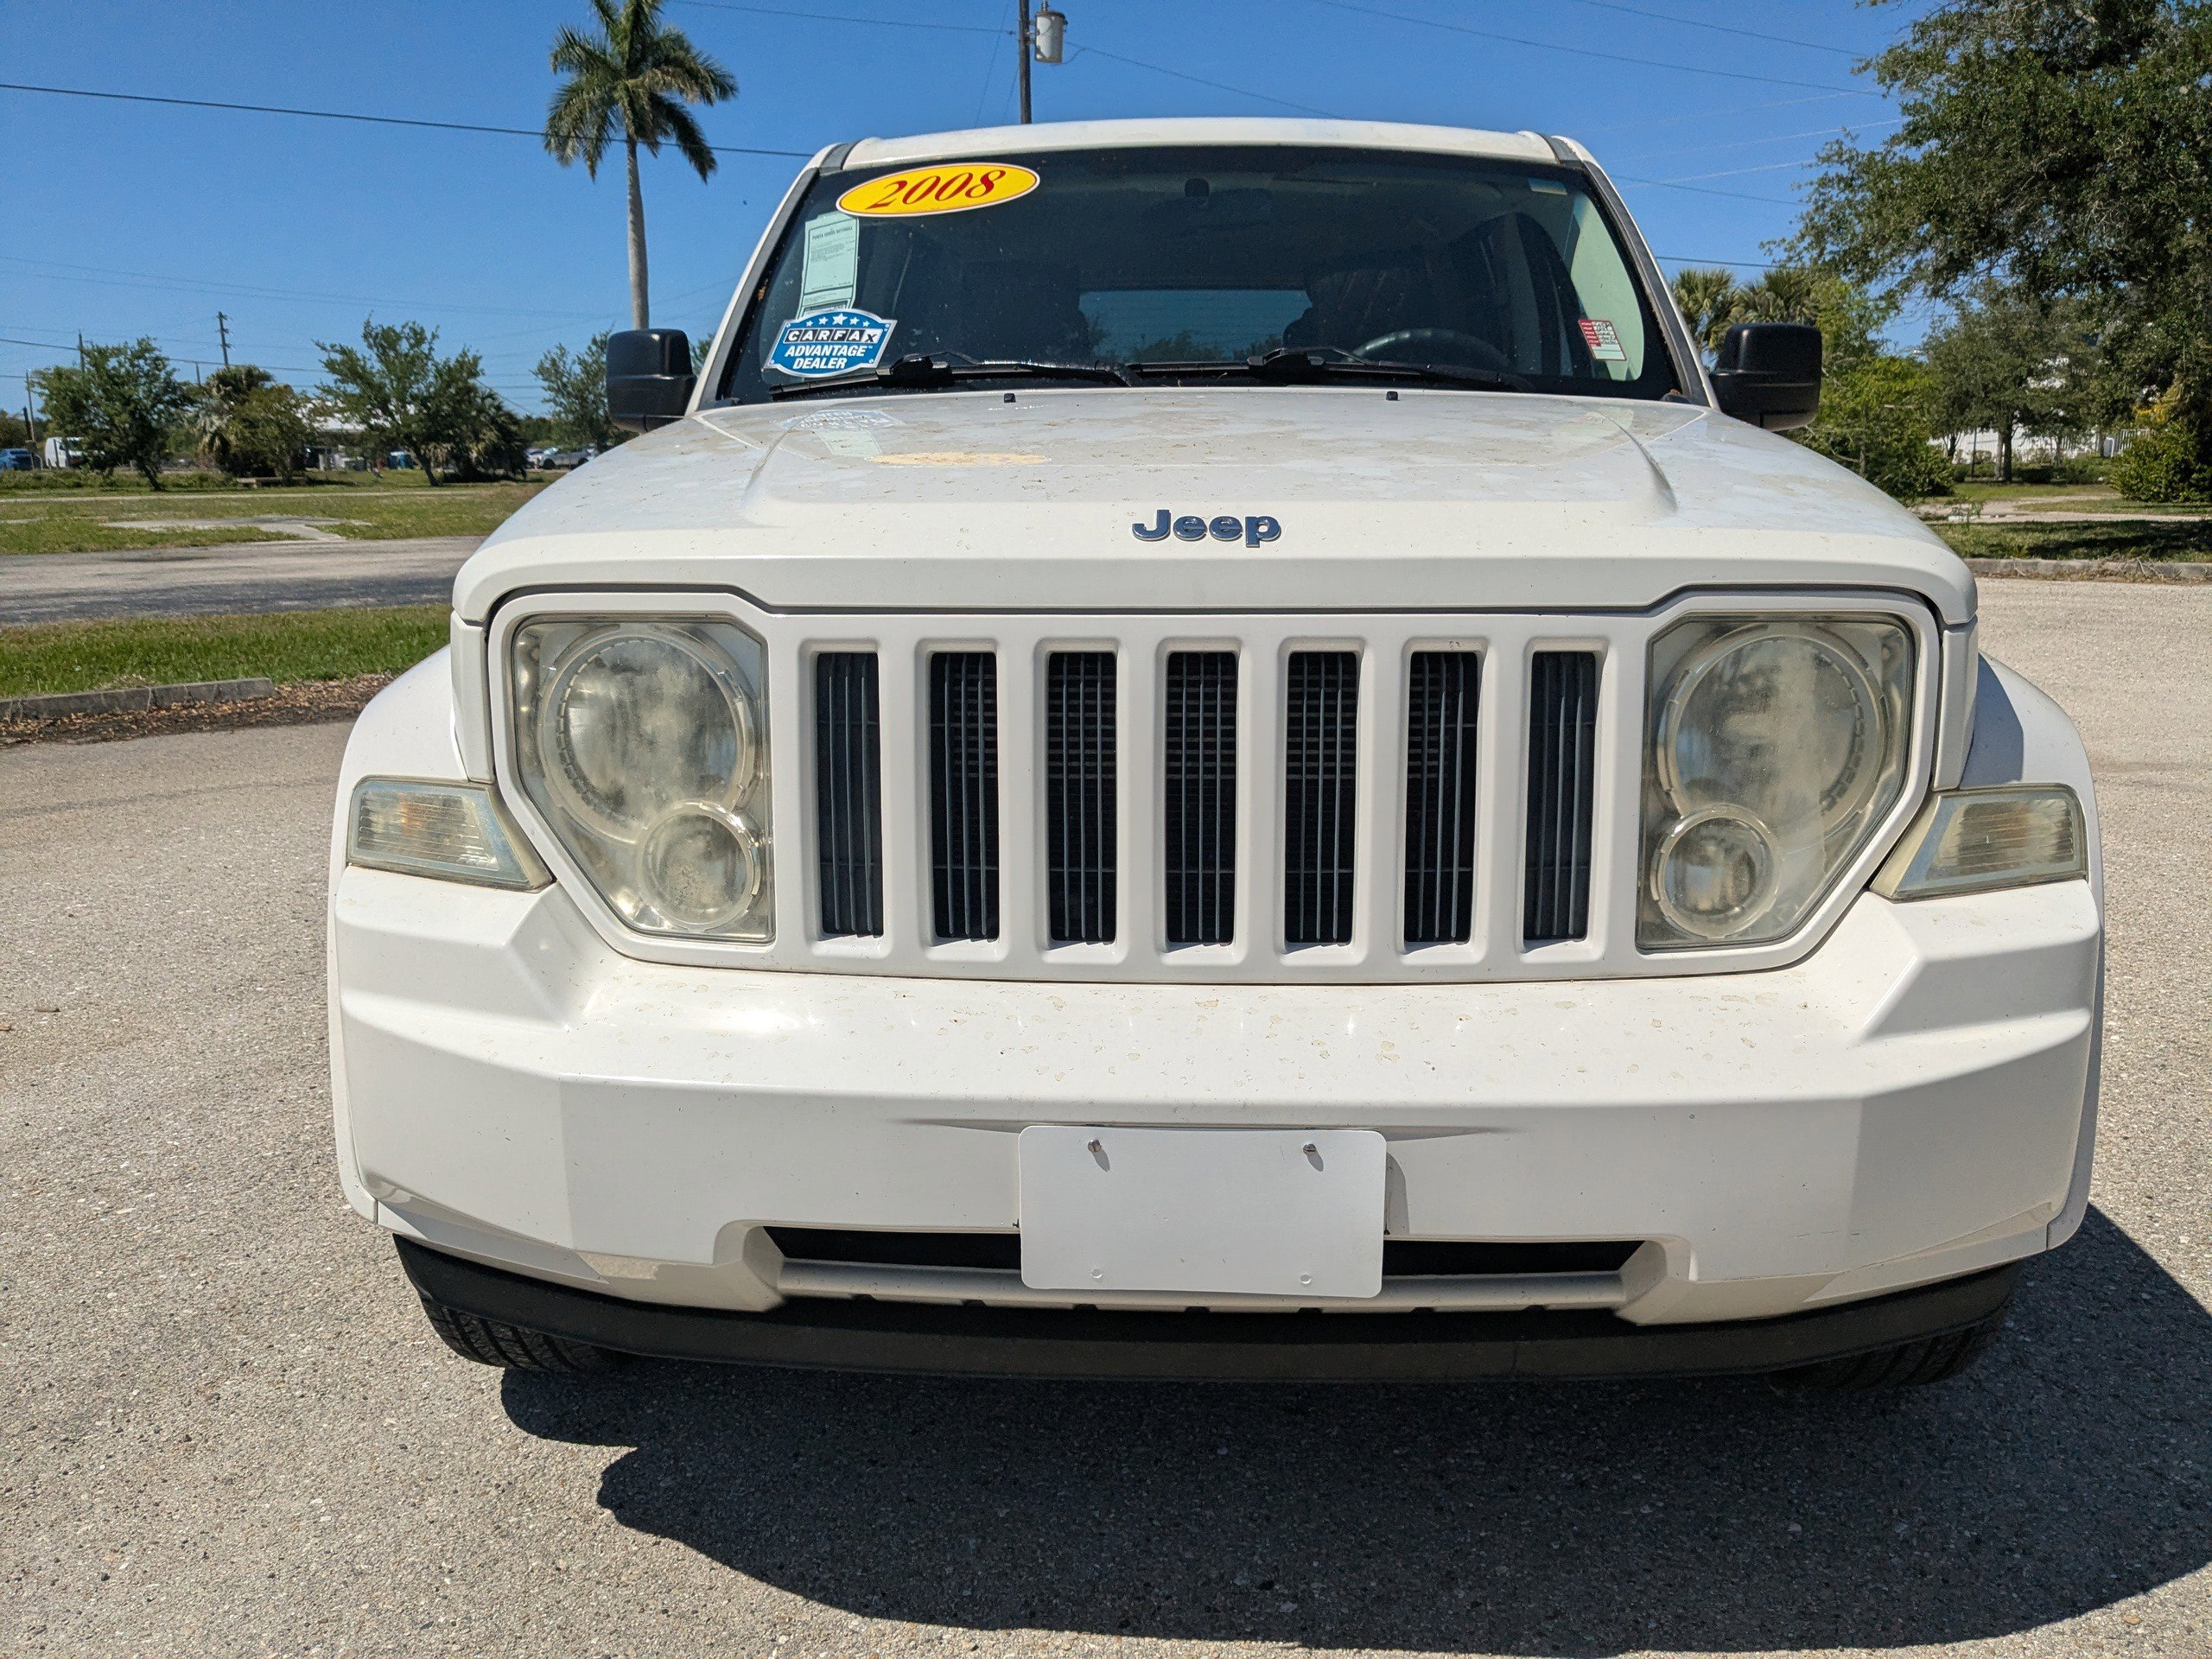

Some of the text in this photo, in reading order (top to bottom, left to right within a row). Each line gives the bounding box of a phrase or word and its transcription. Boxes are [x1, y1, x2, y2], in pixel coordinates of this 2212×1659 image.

[864, 169, 1007, 211] 2008
[786, 329, 878, 343] CARFAX
[785, 345, 868, 357] ADVANTAGE
[792, 357, 848, 369] DEALER
[1131, 509, 1282, 549] Jeep
